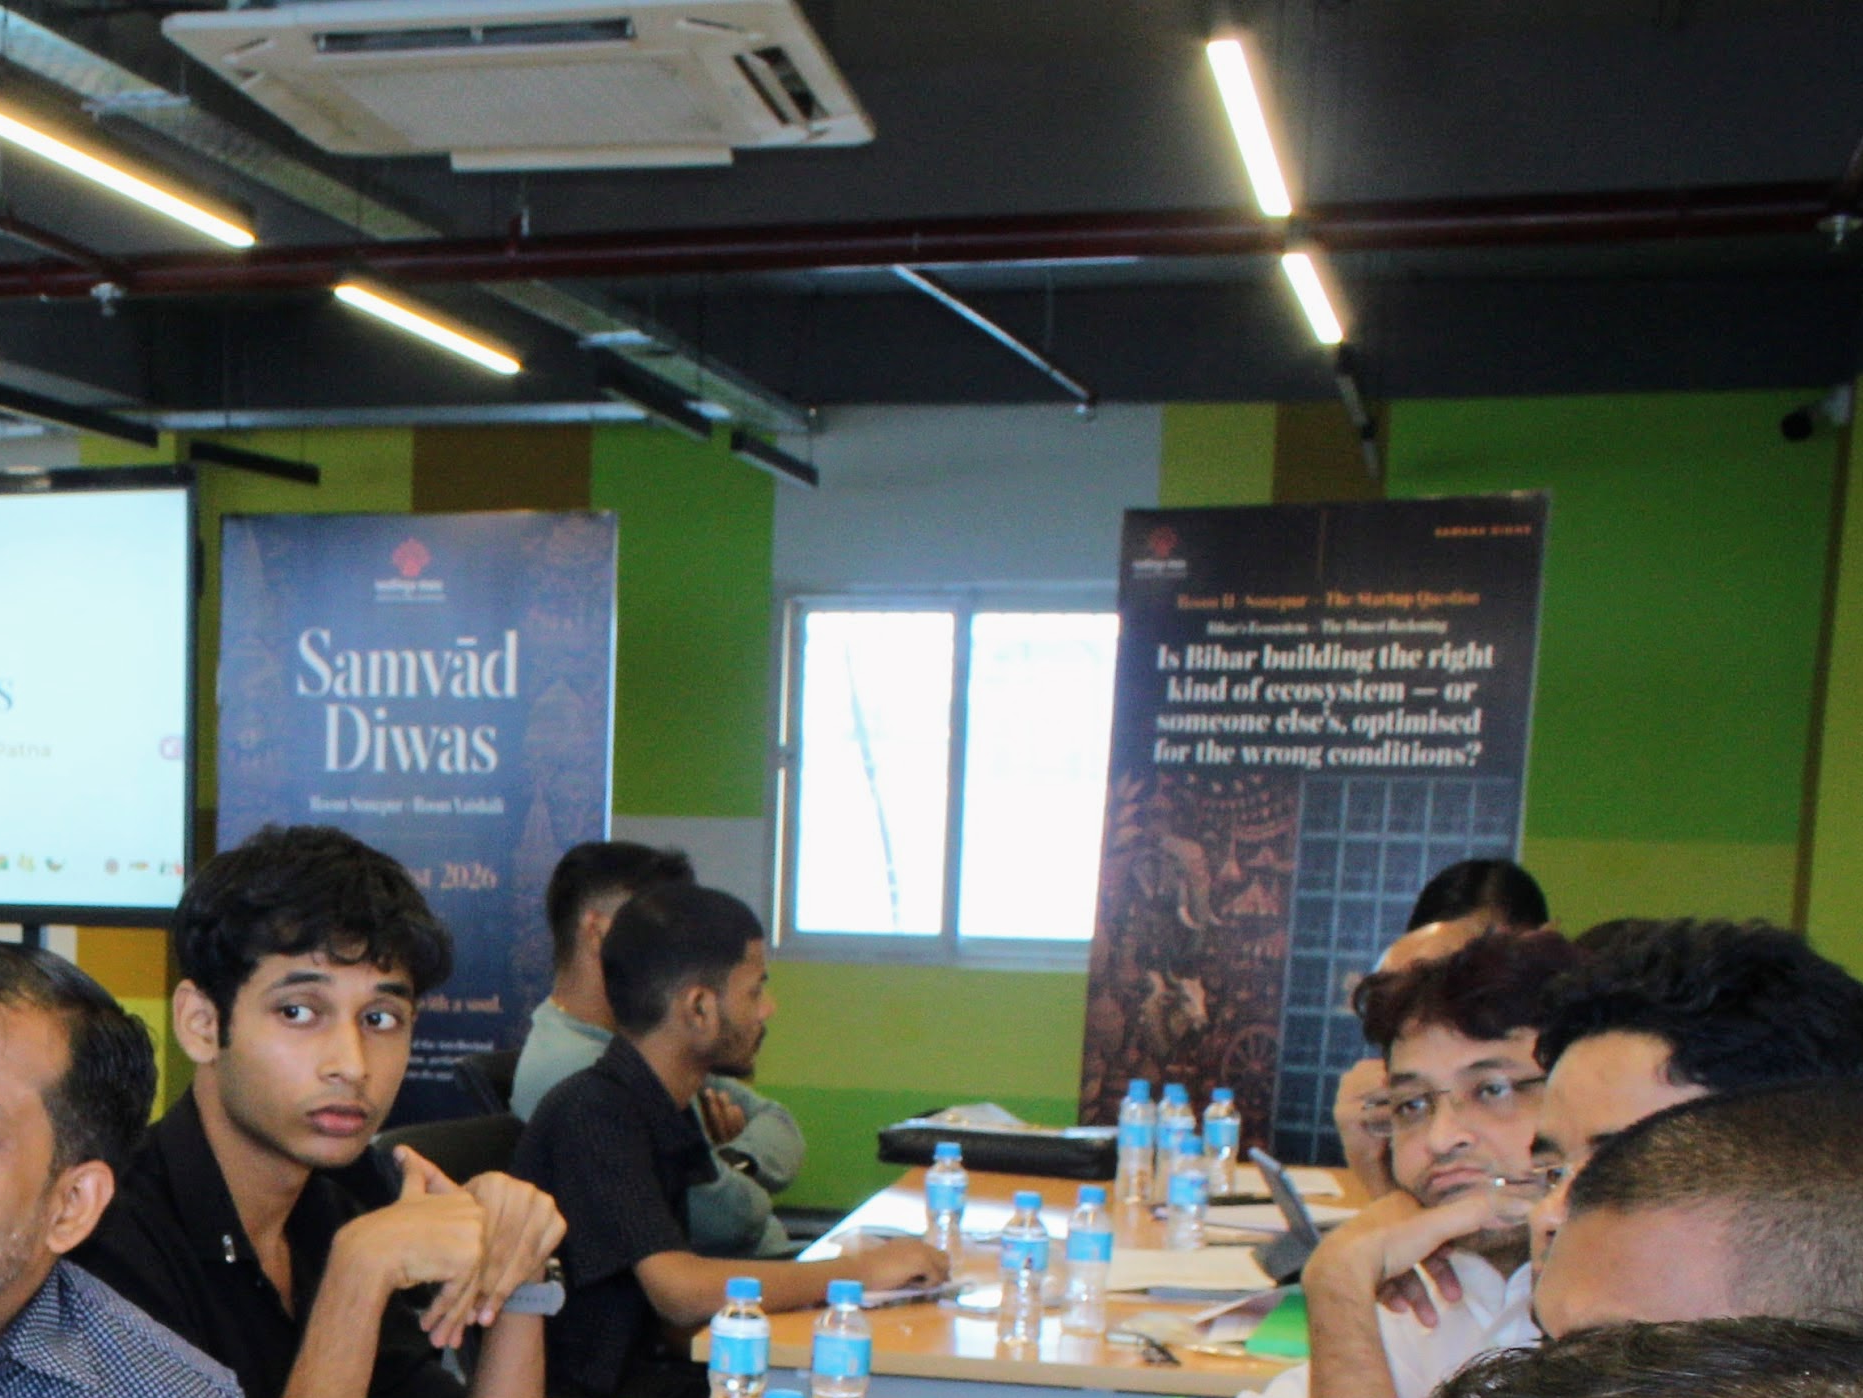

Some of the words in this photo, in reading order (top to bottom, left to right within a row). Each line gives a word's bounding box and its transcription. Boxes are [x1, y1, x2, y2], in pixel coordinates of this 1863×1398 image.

[295, 626, 519, 698] Samvād
[1157, 645, 1180, 670] Is
[1185, 644, 1258, 670] Bihar
[1262, 642, 1375, 674] building
[1378, 641, 1424, 670] the
[1427, 640, 1495, 674] right
[1167, 676, 1228, 703] kind
[1231, 675, 1264, 702] of
[1264, 677, 1406, 710] ecosystem
[1443, 681, 1479, 702] or
[324, 702, 499, 774] Diwas
[1156, 713, 1272, 734] someone
[1352, 707, 1483, 740] optimised
[1153, 737, 1191, 764] for
[1195, 738, 1235, 765] the
[1240, 744, 1325, 770] wrong
[1327, 739, 1483, 768] conditions?
